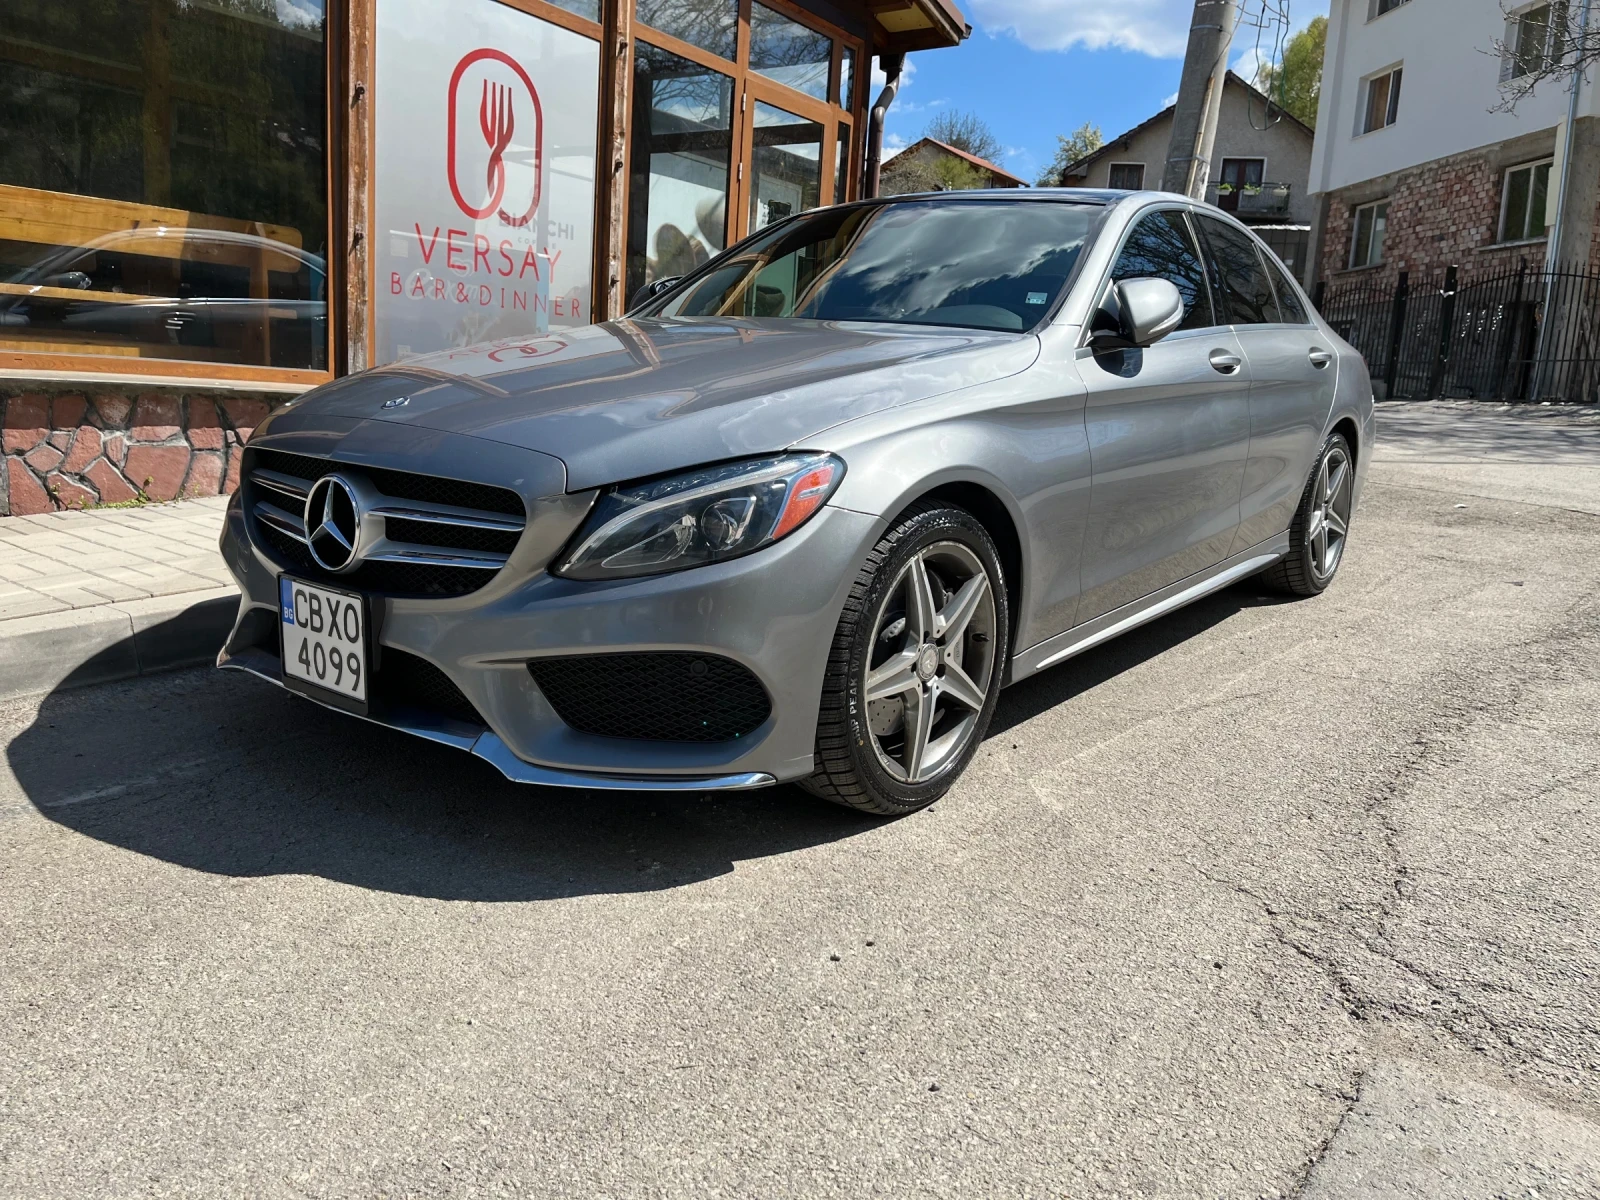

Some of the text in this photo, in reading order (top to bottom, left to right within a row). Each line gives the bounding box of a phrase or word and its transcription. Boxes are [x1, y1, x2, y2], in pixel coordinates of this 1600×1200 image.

[415, 223, 562, 284] VERSAY
[517, 236, 557, 250] COFE
[284, 606, 294, 620] BG
[294, 588, 360, 644] CBXO
[298, 637, 361, 692] 4099
[848, 677, 858, 715] PEAK
